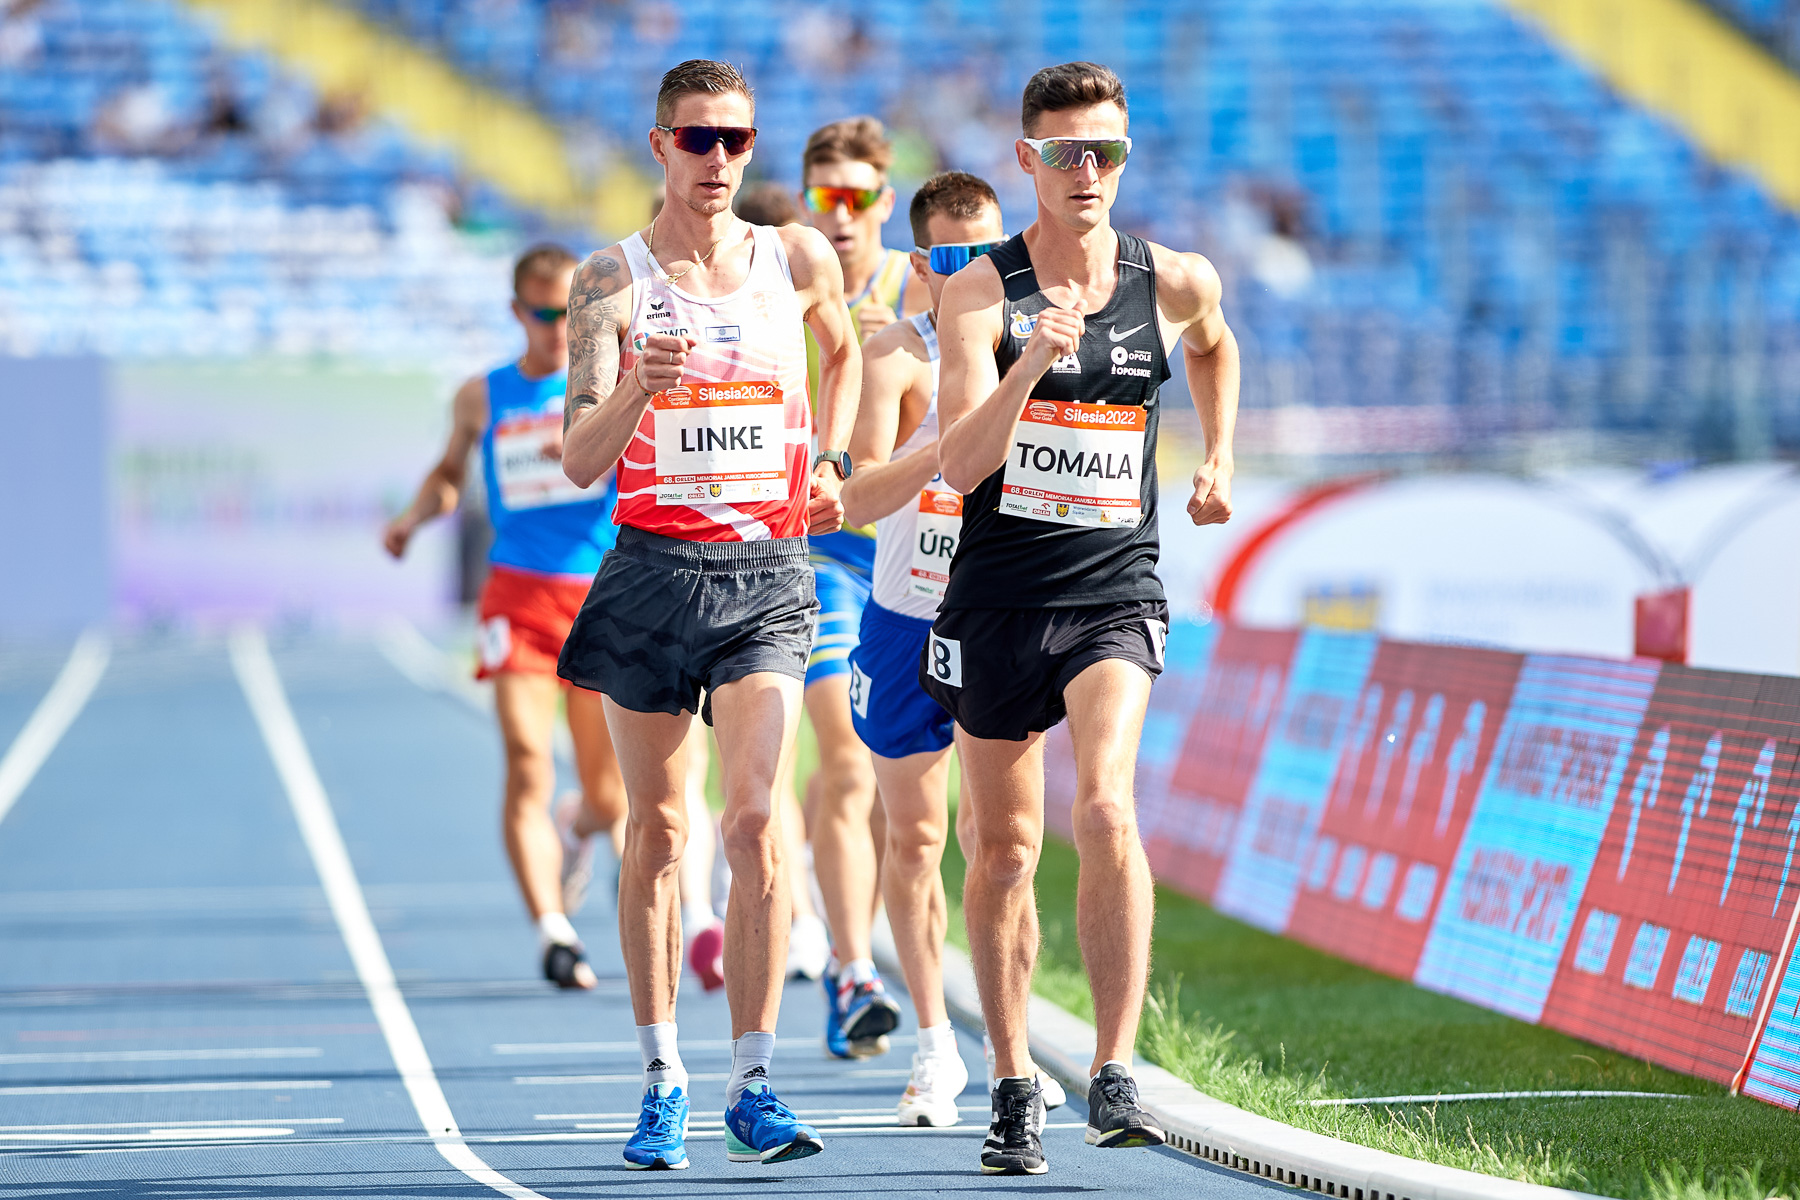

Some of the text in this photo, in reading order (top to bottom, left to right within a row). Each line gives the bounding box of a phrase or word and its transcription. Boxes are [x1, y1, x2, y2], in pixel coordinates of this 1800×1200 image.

[646, 311, 671, 320] erima
[1128, 352, 1152, 362] OPOLE
[1116, 366, 1152, 378] OPOLSKIE
[698, 385, 774, 401] Silesia2022
[1030, 410, 1055, 418] Continental
[1063, 407, 1136, 425] Silesia2022
[680, 425, 763, 453] LINKE
[1016, 441, 1133, 480] TOMALA
[1010, 486, 1022, 495] 68.
[1023, 489, 1044, 498] ORLEN
[1045, 493, 1073, 501] MEMORIAŁ
[1073, 497, 1097, 505] JANUSZA
[1033, 508, 1050, 516] ORLEN
[920, 528, 956, 559] ÚR
[932, 639, 952, 681] 8
[646, 1064, 671, 1073] adidas
